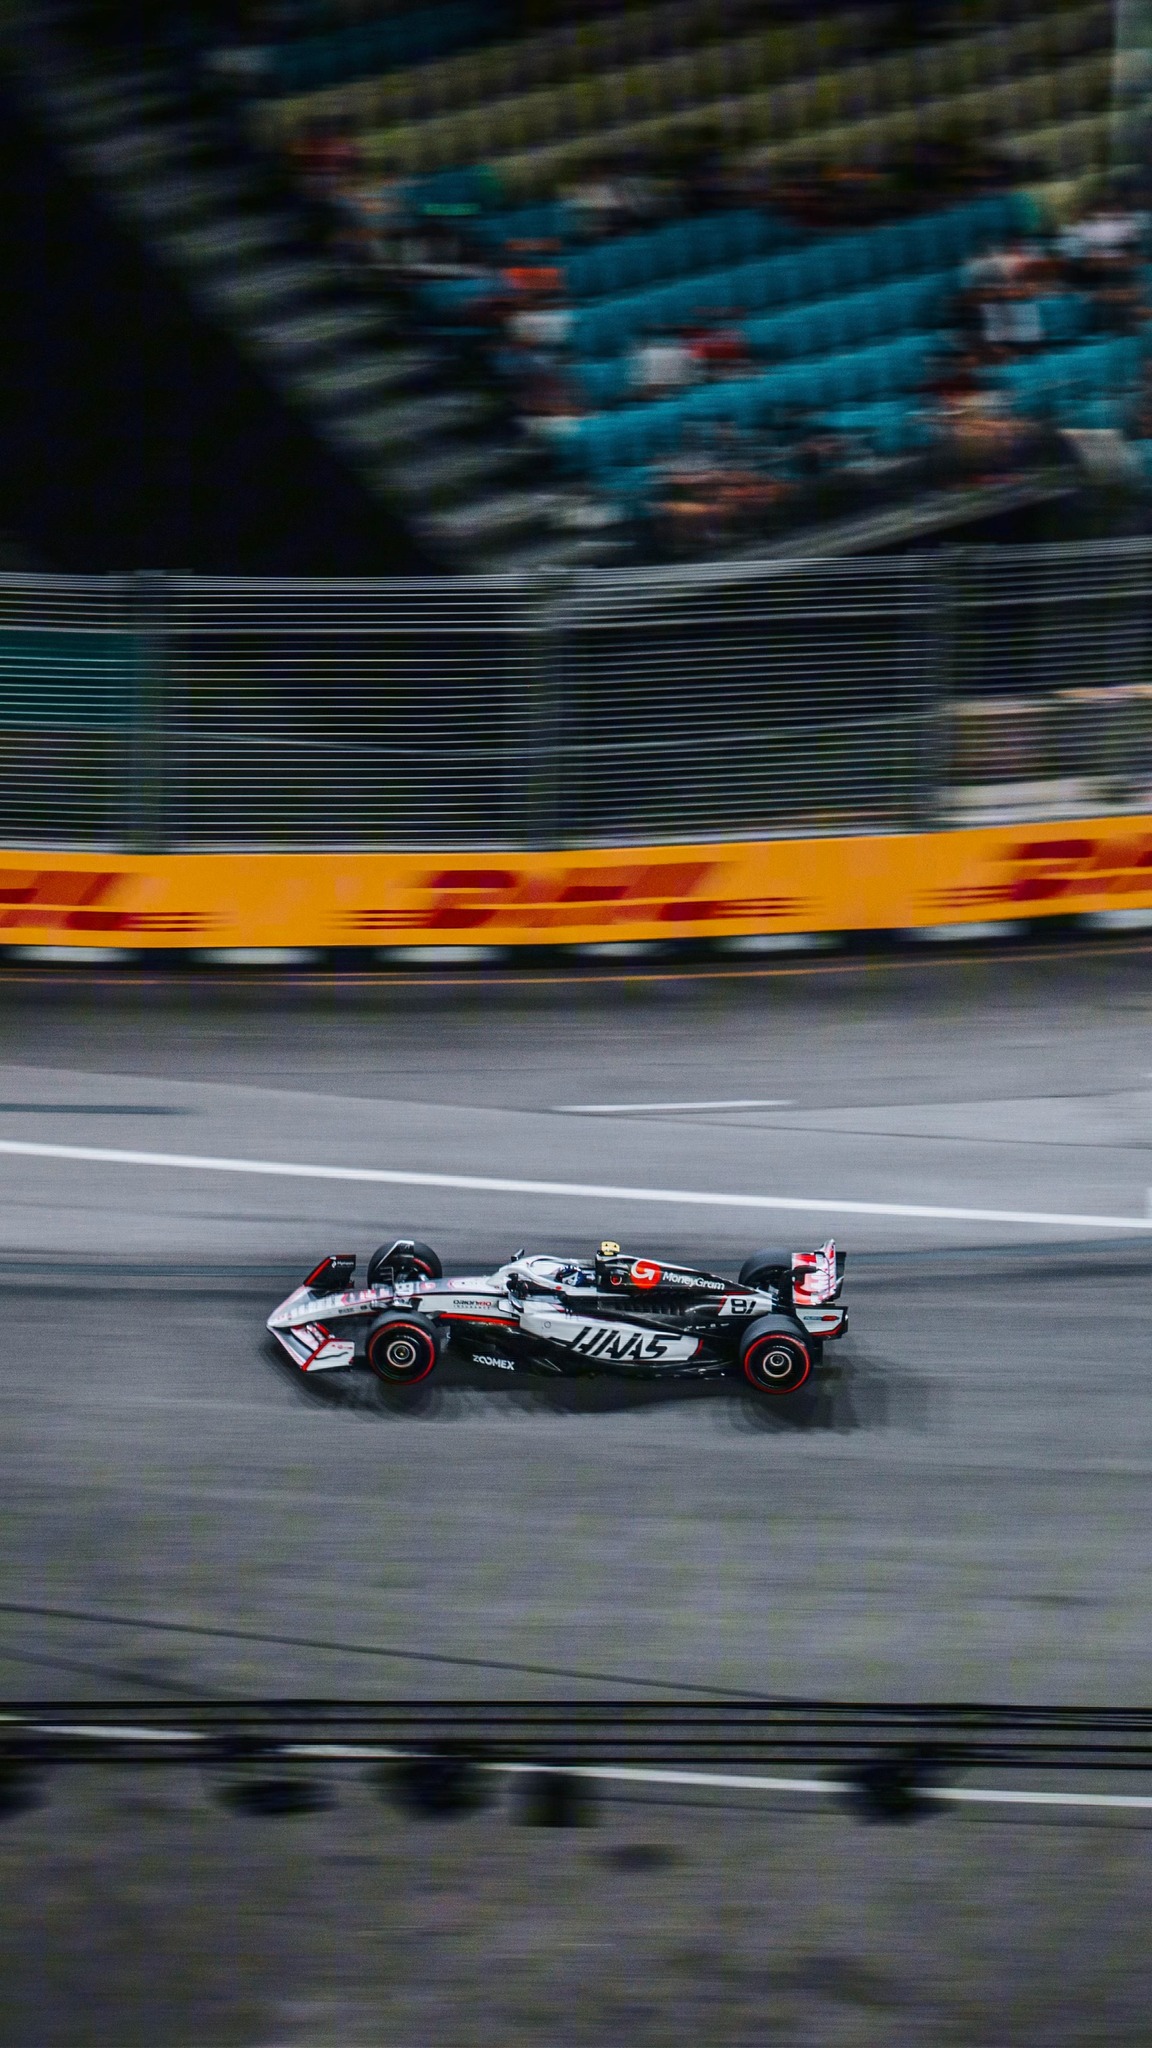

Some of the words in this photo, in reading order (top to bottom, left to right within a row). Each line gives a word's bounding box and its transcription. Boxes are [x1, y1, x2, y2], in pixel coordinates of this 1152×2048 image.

[662, 1271, 725, 1291] MoneyGram
[567, 1326, 682, 1360] HAAS
[472, 1354, 515, 1371] ZOOMEX
